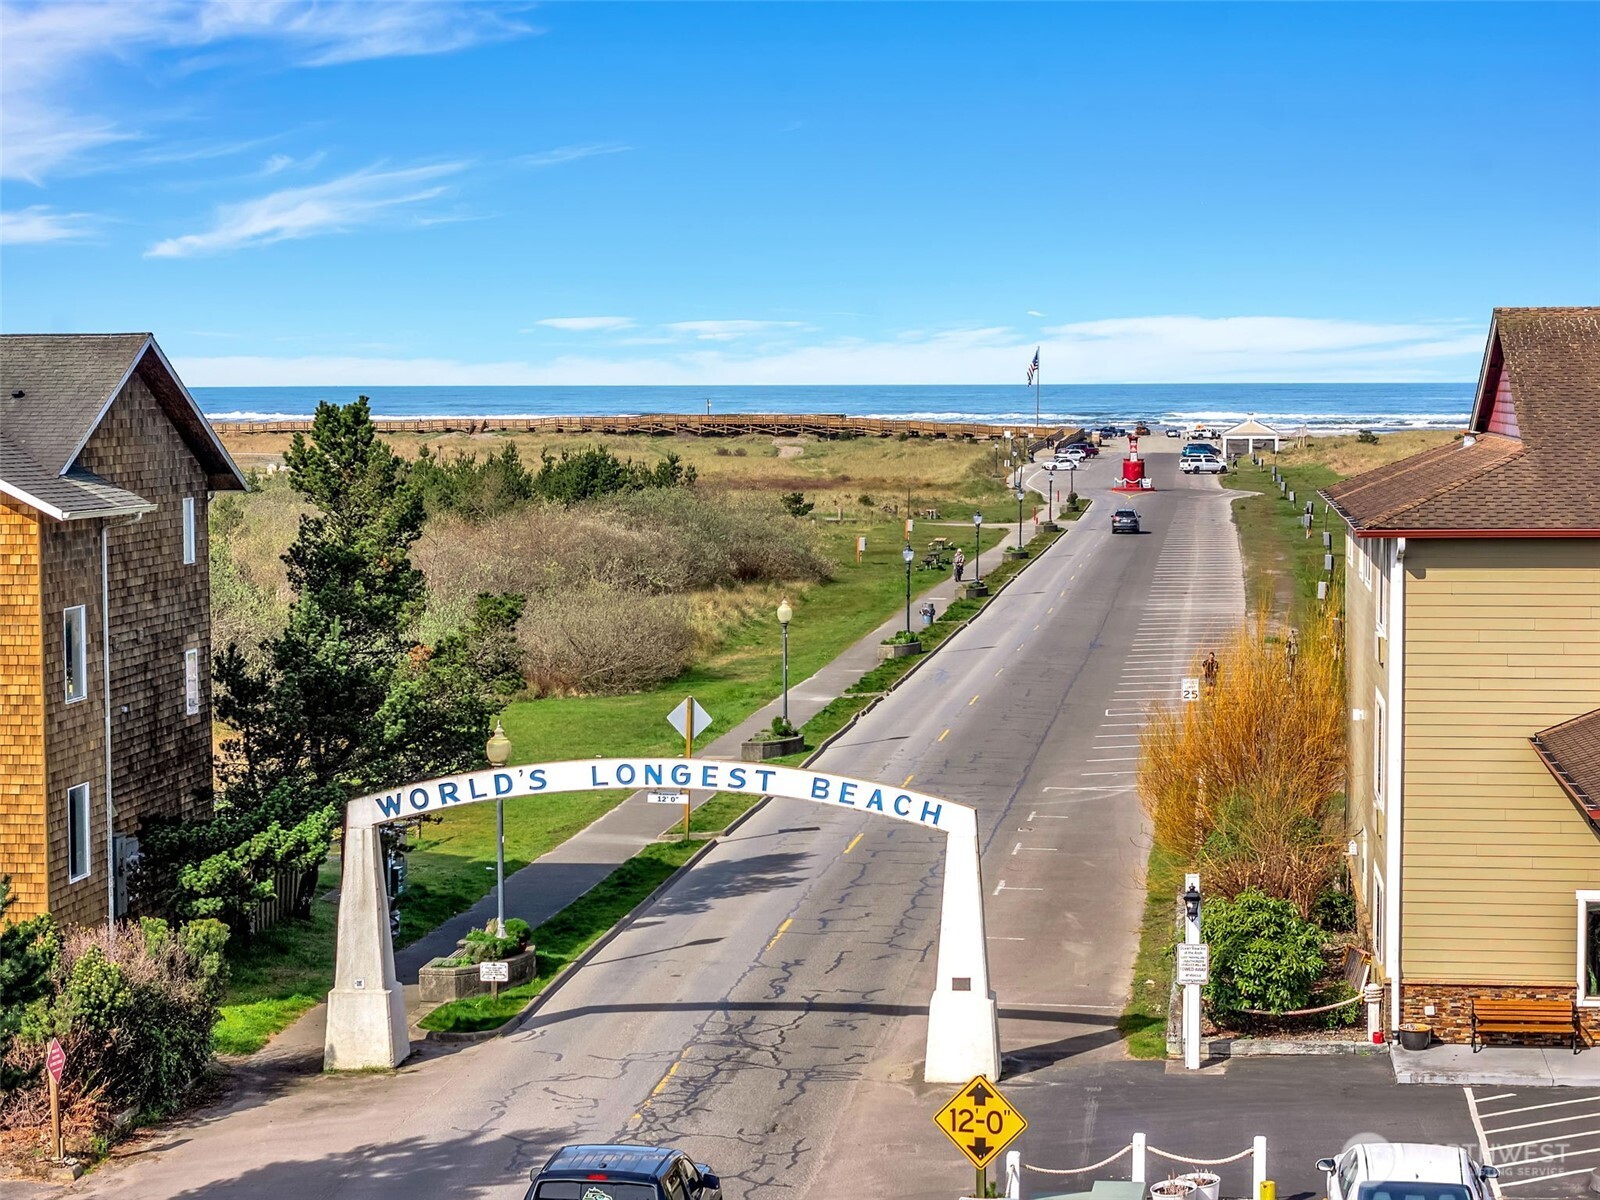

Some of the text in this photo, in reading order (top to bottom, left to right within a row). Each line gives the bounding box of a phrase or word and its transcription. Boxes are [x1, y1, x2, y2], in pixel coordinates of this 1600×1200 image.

[1183, 690, 1198, 699] 25
[375, 763, 942, 825] WORLD'S LONGEST BEACH
